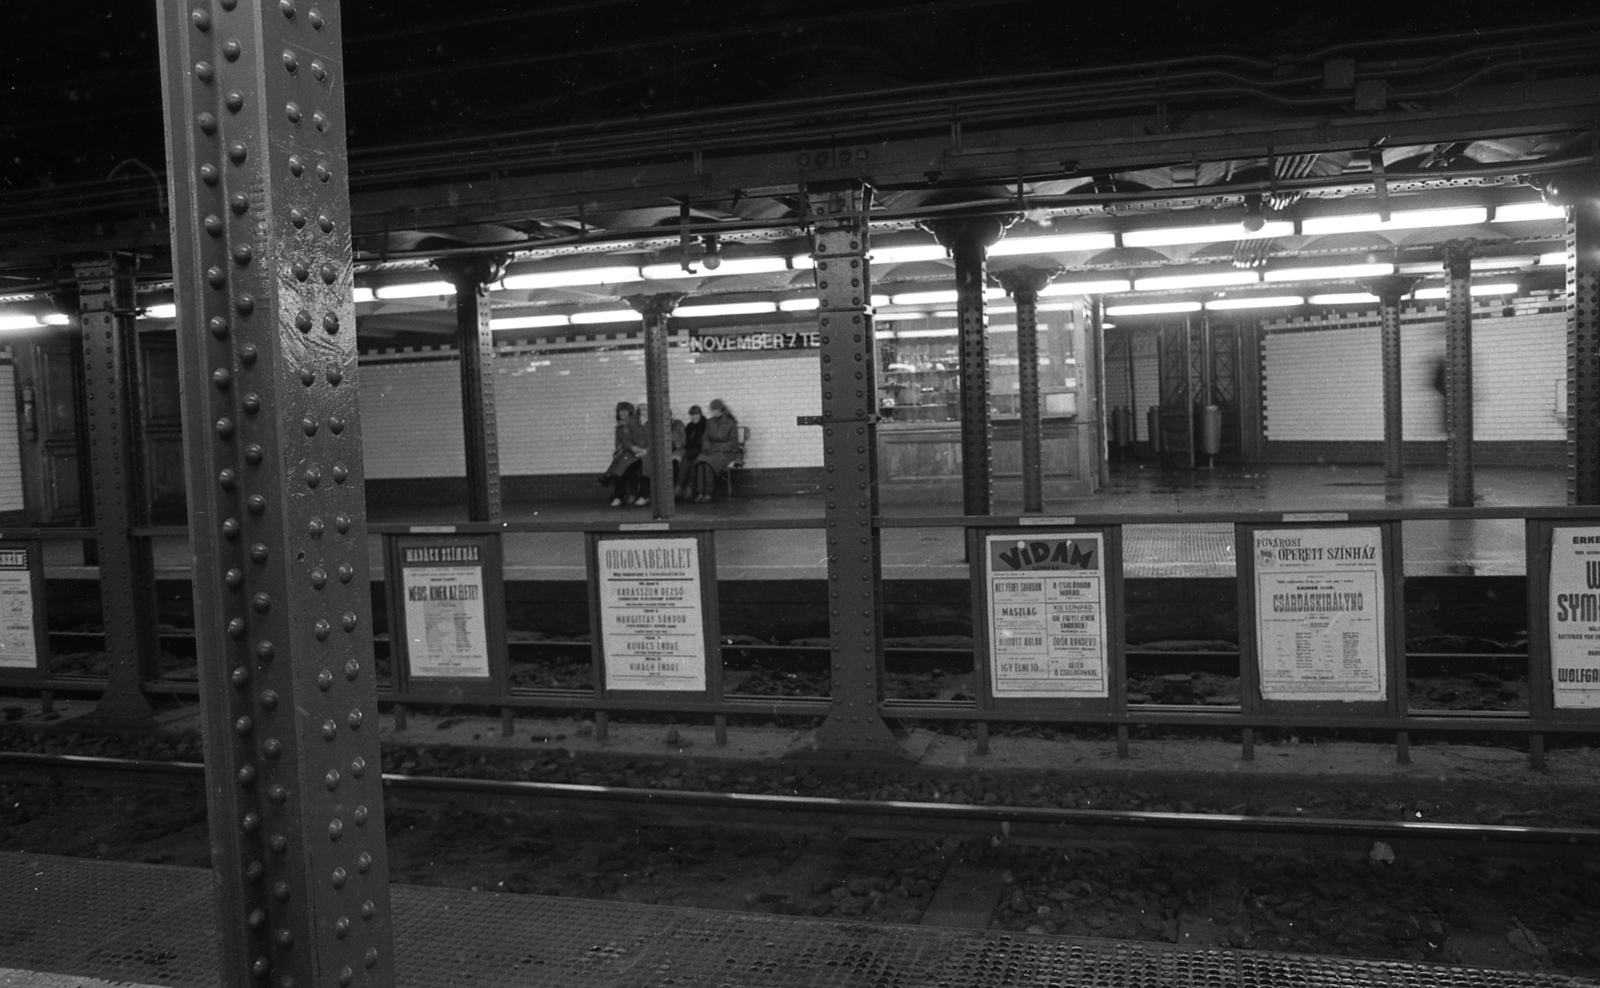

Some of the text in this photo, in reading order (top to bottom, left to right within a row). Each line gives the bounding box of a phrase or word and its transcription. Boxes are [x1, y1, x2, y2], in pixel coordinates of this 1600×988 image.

[690, 333, 784, 351] NOVEMBER
[786, 333, 796, 347] 7
[406, 545, 479, 562] MADÁCH SZÍNHÁZ
[605, 547, 692, 570] ORGONABÉRLET
[1278, 544, 1376, 562] OPERETT SZÍNHÁZ
[1002, 608, 1037, 617] MASZLAG
[1557, 594, 1600, 622] SYM
[616, 614, 687, 623] MARGITTAY SÁNDOR
[627, 641, 678, 650] KOVÁCS ENDRE
[657, 663, 679, 671] ENDRE
[1558, 668, 1600, 683] WOLFGA
